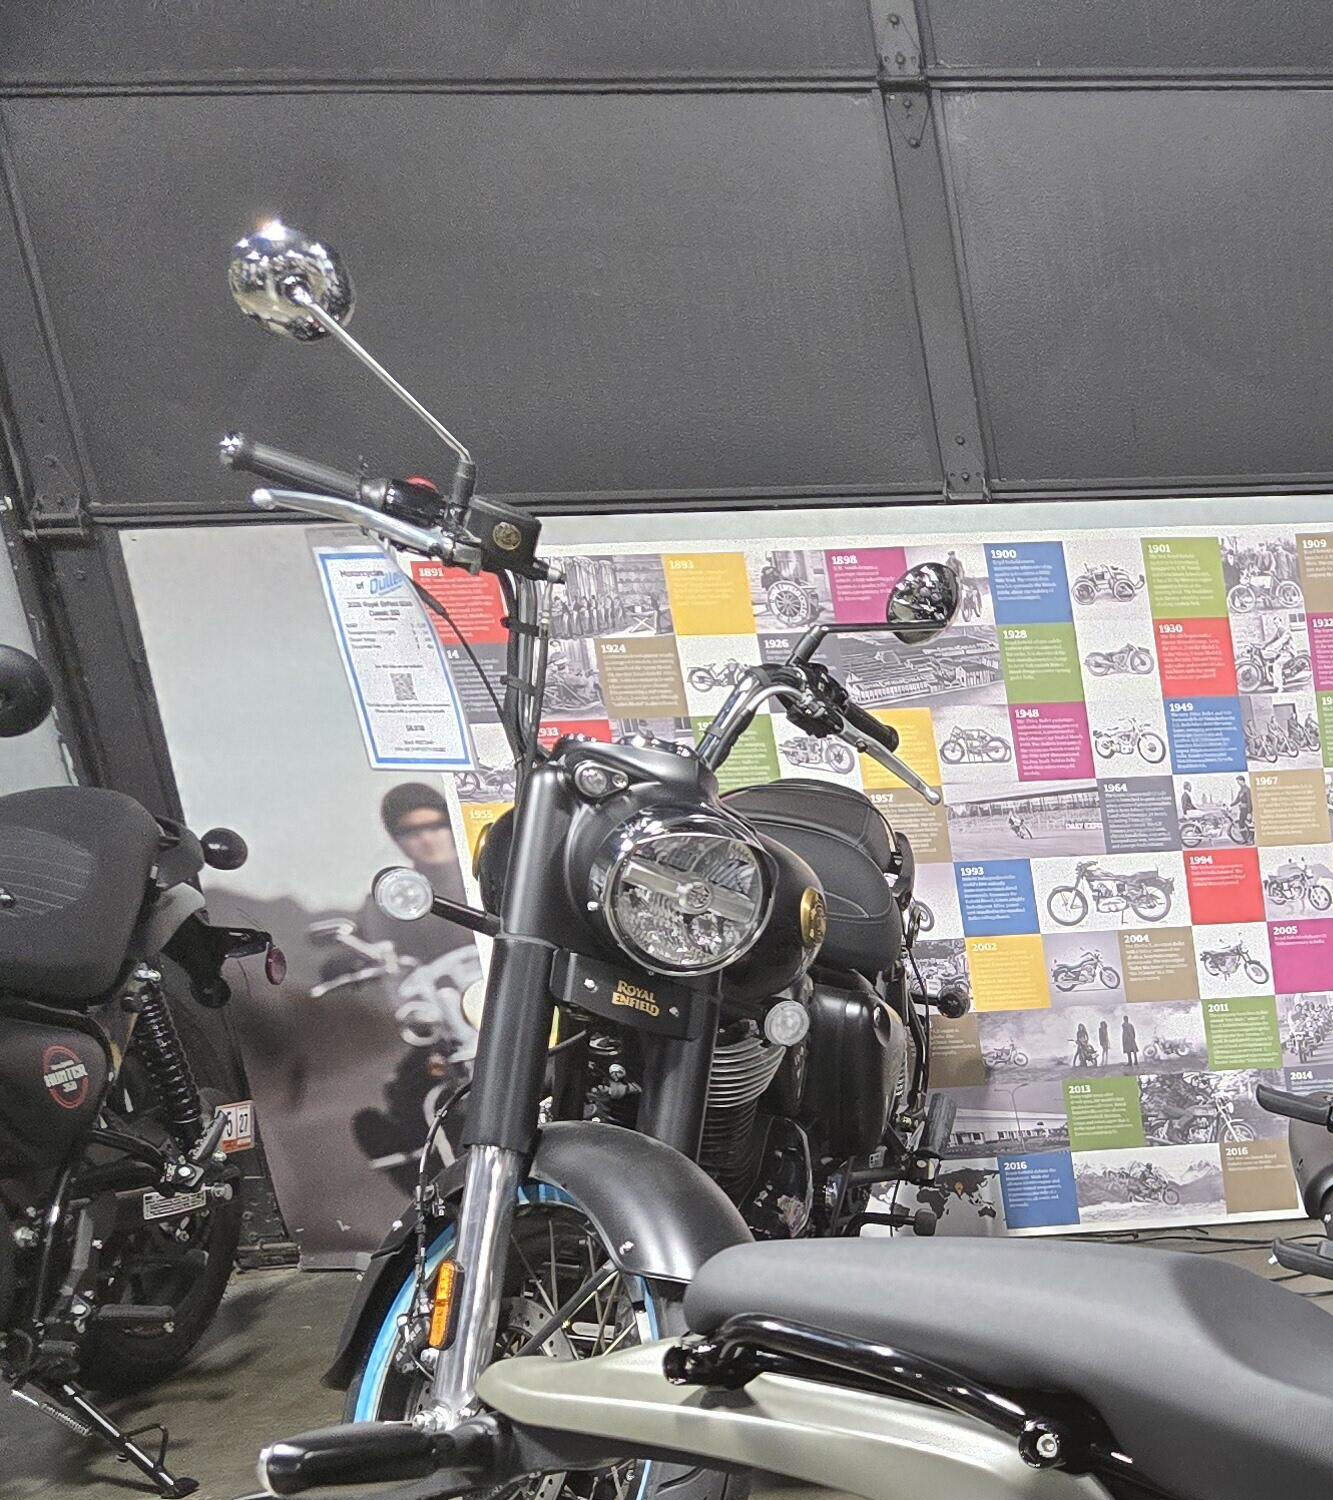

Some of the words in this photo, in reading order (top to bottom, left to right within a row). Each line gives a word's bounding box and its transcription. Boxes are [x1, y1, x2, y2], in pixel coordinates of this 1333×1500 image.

[1147, 544, 1171, 554] 1901
[1303, 539, 1327, 549] 1909
[832, 555, 857, 564] 1898
[991, 549, 1016, 560] 1900
[419, 568, 444, 577] 1891
[1159, 624, 1183, 634] 1930
[1003, 629, 1028, 640] 1928
[601, 644, 626, 653] 1924
[764, 639, 789, 648] 1926
[1014, 708, 1039, 718] 1948
[1169, 703, 1194, 713] 1949
[1255, 776, 1279, 787] 1967
[1103, 783, 1128, 793] 1964
[870, 793, 893, 803] 1957
[1189, 856, 1213, 866] 1994
[960, 866, 985, 877] 1993
[1273, 926, 1298, 936] 2005
[1123, 934, 1150, 944] 2004
[971, 942, 997, 952] 2002
[617, 980, 656, 1003] ROYAL
[612, 991, 660, 1017] ENFIELD
[1208, 1004, 1230, 1013] 2011
[1290, 1071, 1313, 1080] 2014
[1068, 1085, 1092, 1095] 2013
[239, 1113, 248, 1133] 27
[1225, 1147, 1248, 1157] 2016
[1003, 1161, 1027, 1171] 2016
